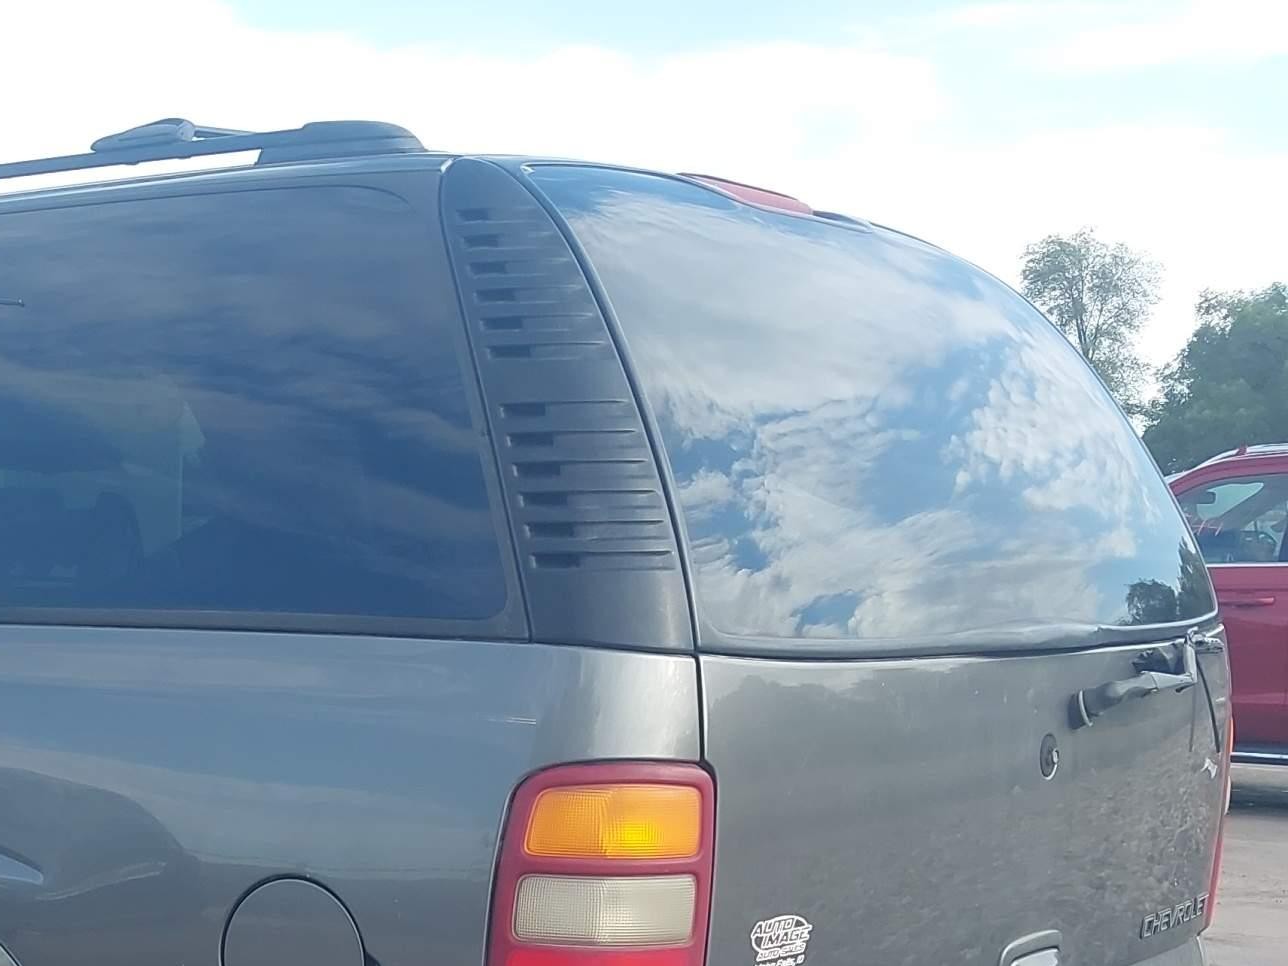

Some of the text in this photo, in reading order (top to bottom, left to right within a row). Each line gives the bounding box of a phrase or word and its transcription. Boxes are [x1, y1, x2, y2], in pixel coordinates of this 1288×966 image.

[752, 918, 795, 937] AUTO
[761, 929, 810, 948] IMAGE
[757, 943, 806, 961] AUTO SALES
